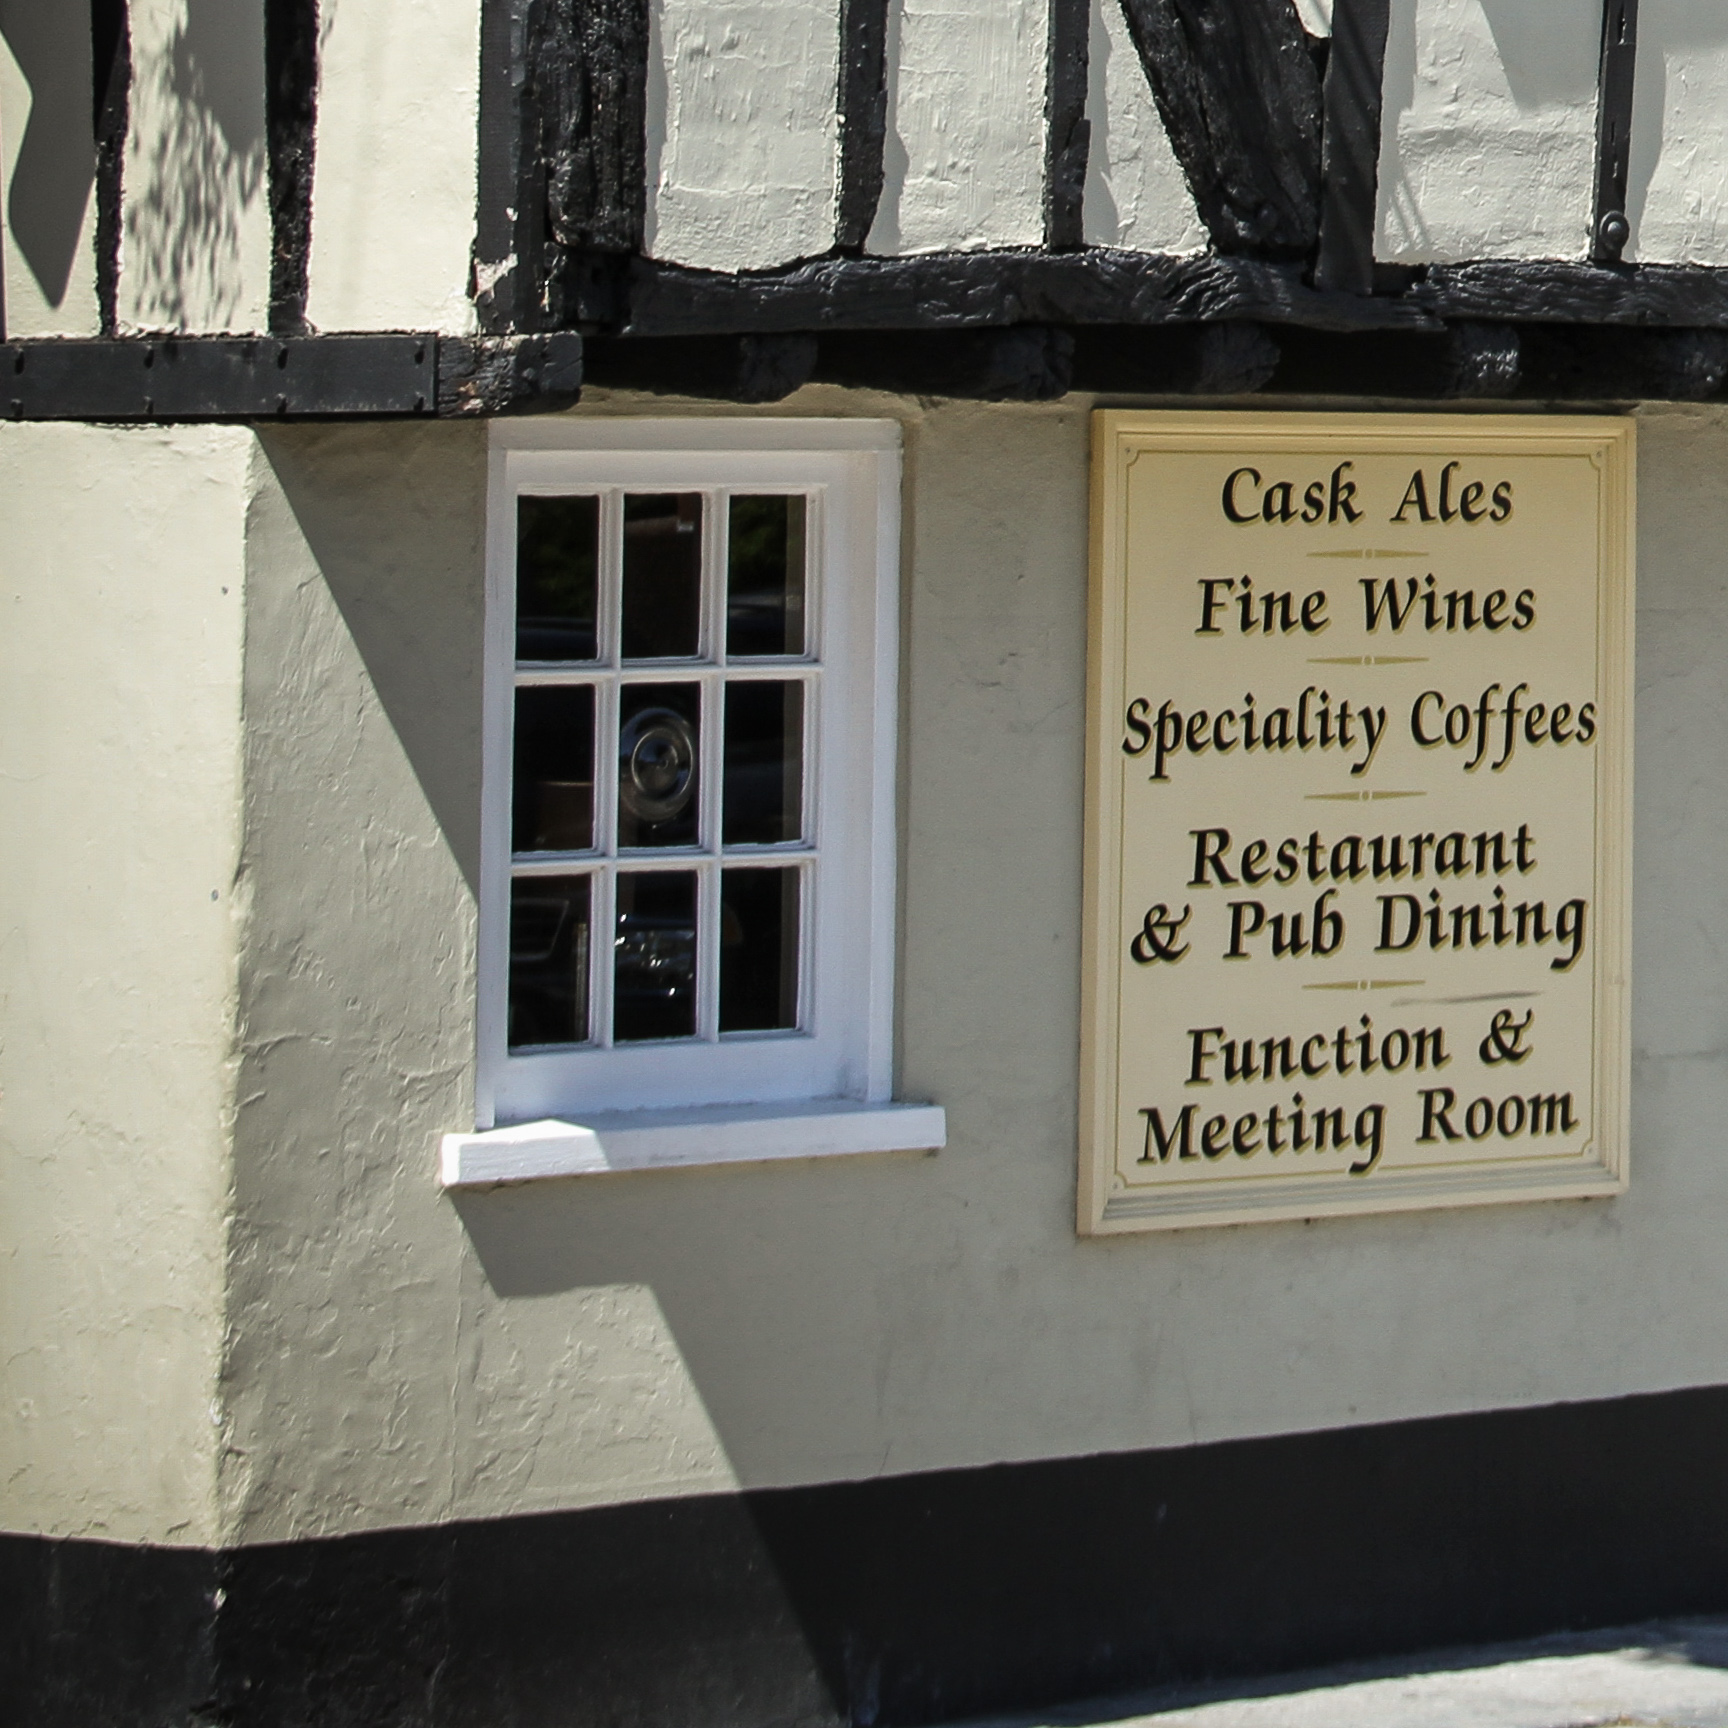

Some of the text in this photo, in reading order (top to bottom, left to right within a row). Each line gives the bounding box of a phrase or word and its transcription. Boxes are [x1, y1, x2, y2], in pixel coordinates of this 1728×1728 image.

[1221, 460, 1514, 524] Cask Ales
[1194, 572, 1537, 636] Fine Wines
[1122, 681, 1597, 780] Speciality Coffees
[1187, 822, 1537, 889] Restaurant
[1129, 885, 1589, 970] & Pub Dining
[1184, 1008, 1535, 1088] Function &
[1136, 1084, 1578, 1174] Meeting Room
